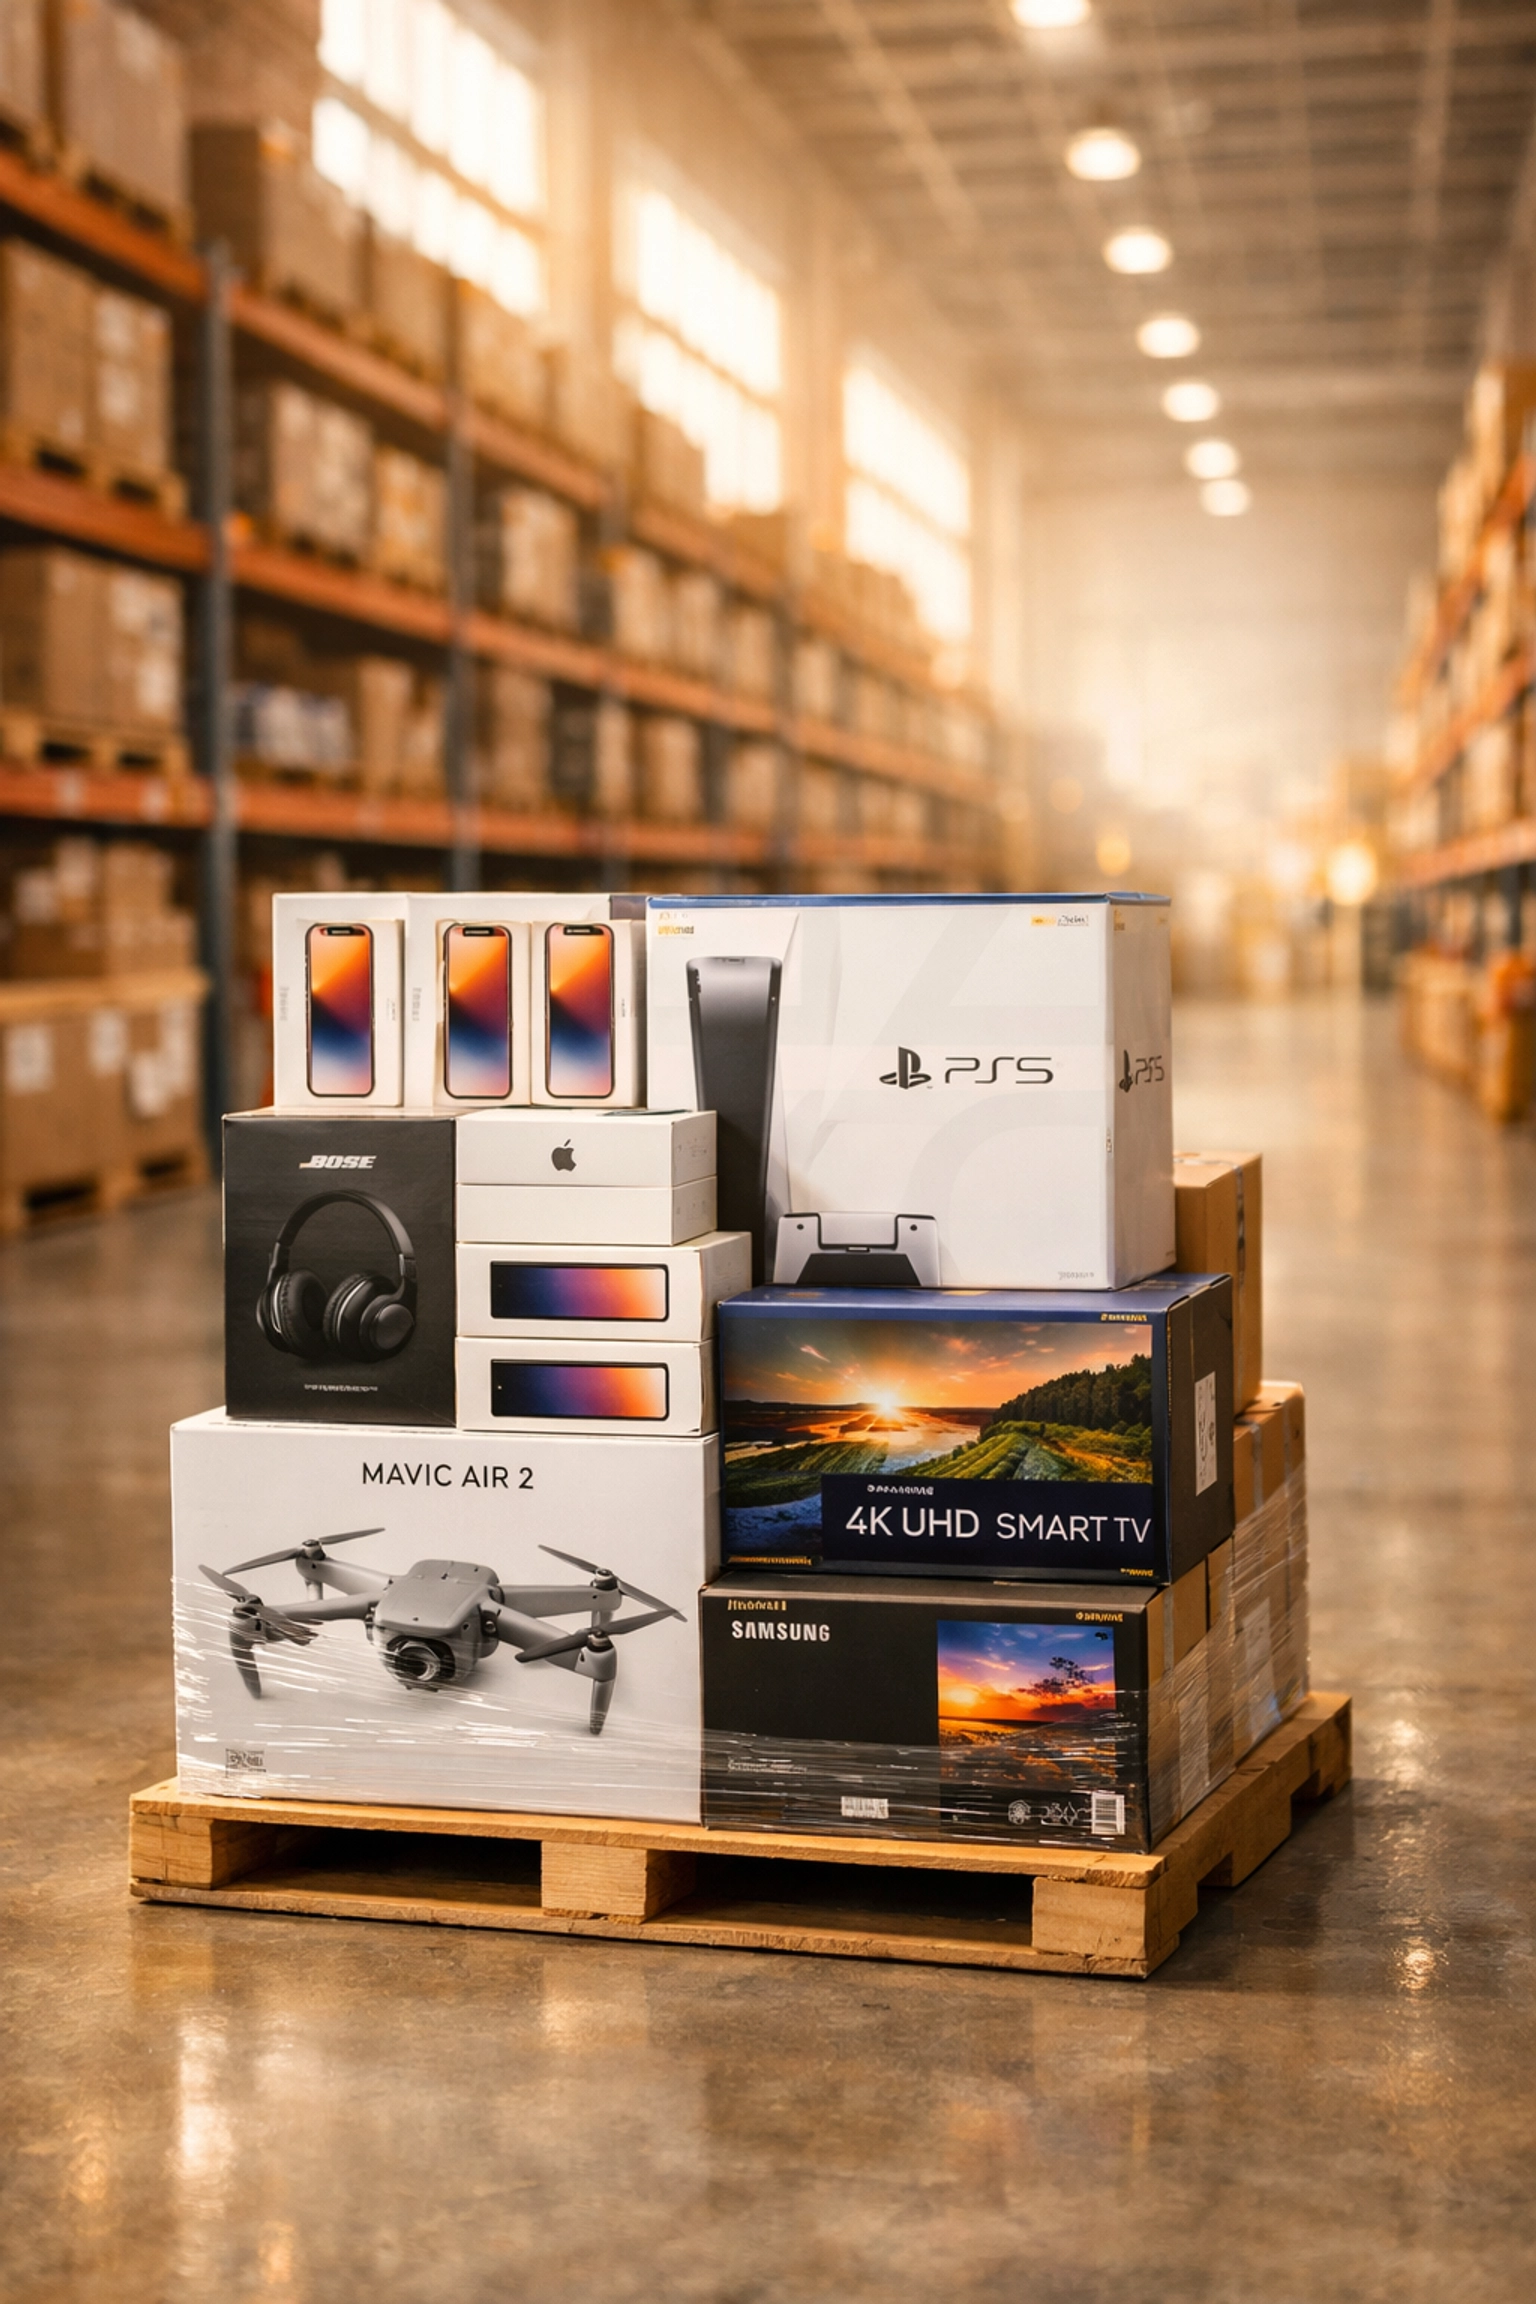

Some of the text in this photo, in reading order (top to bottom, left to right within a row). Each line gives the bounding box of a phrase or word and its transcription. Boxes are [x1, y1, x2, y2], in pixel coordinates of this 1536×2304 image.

[944, 1056, 1055, 1084] PS5
[1135, 1054, 1166, 1086] PS5
[298, 1154, 378, 1171] BOSE
[361, 1462, 535, 1490] MAVIC AIR 2
[844, 1505, 1152, 1544] 4K UHD SMART TV
[730, 1619, 831, 1642] SAMSUNG
